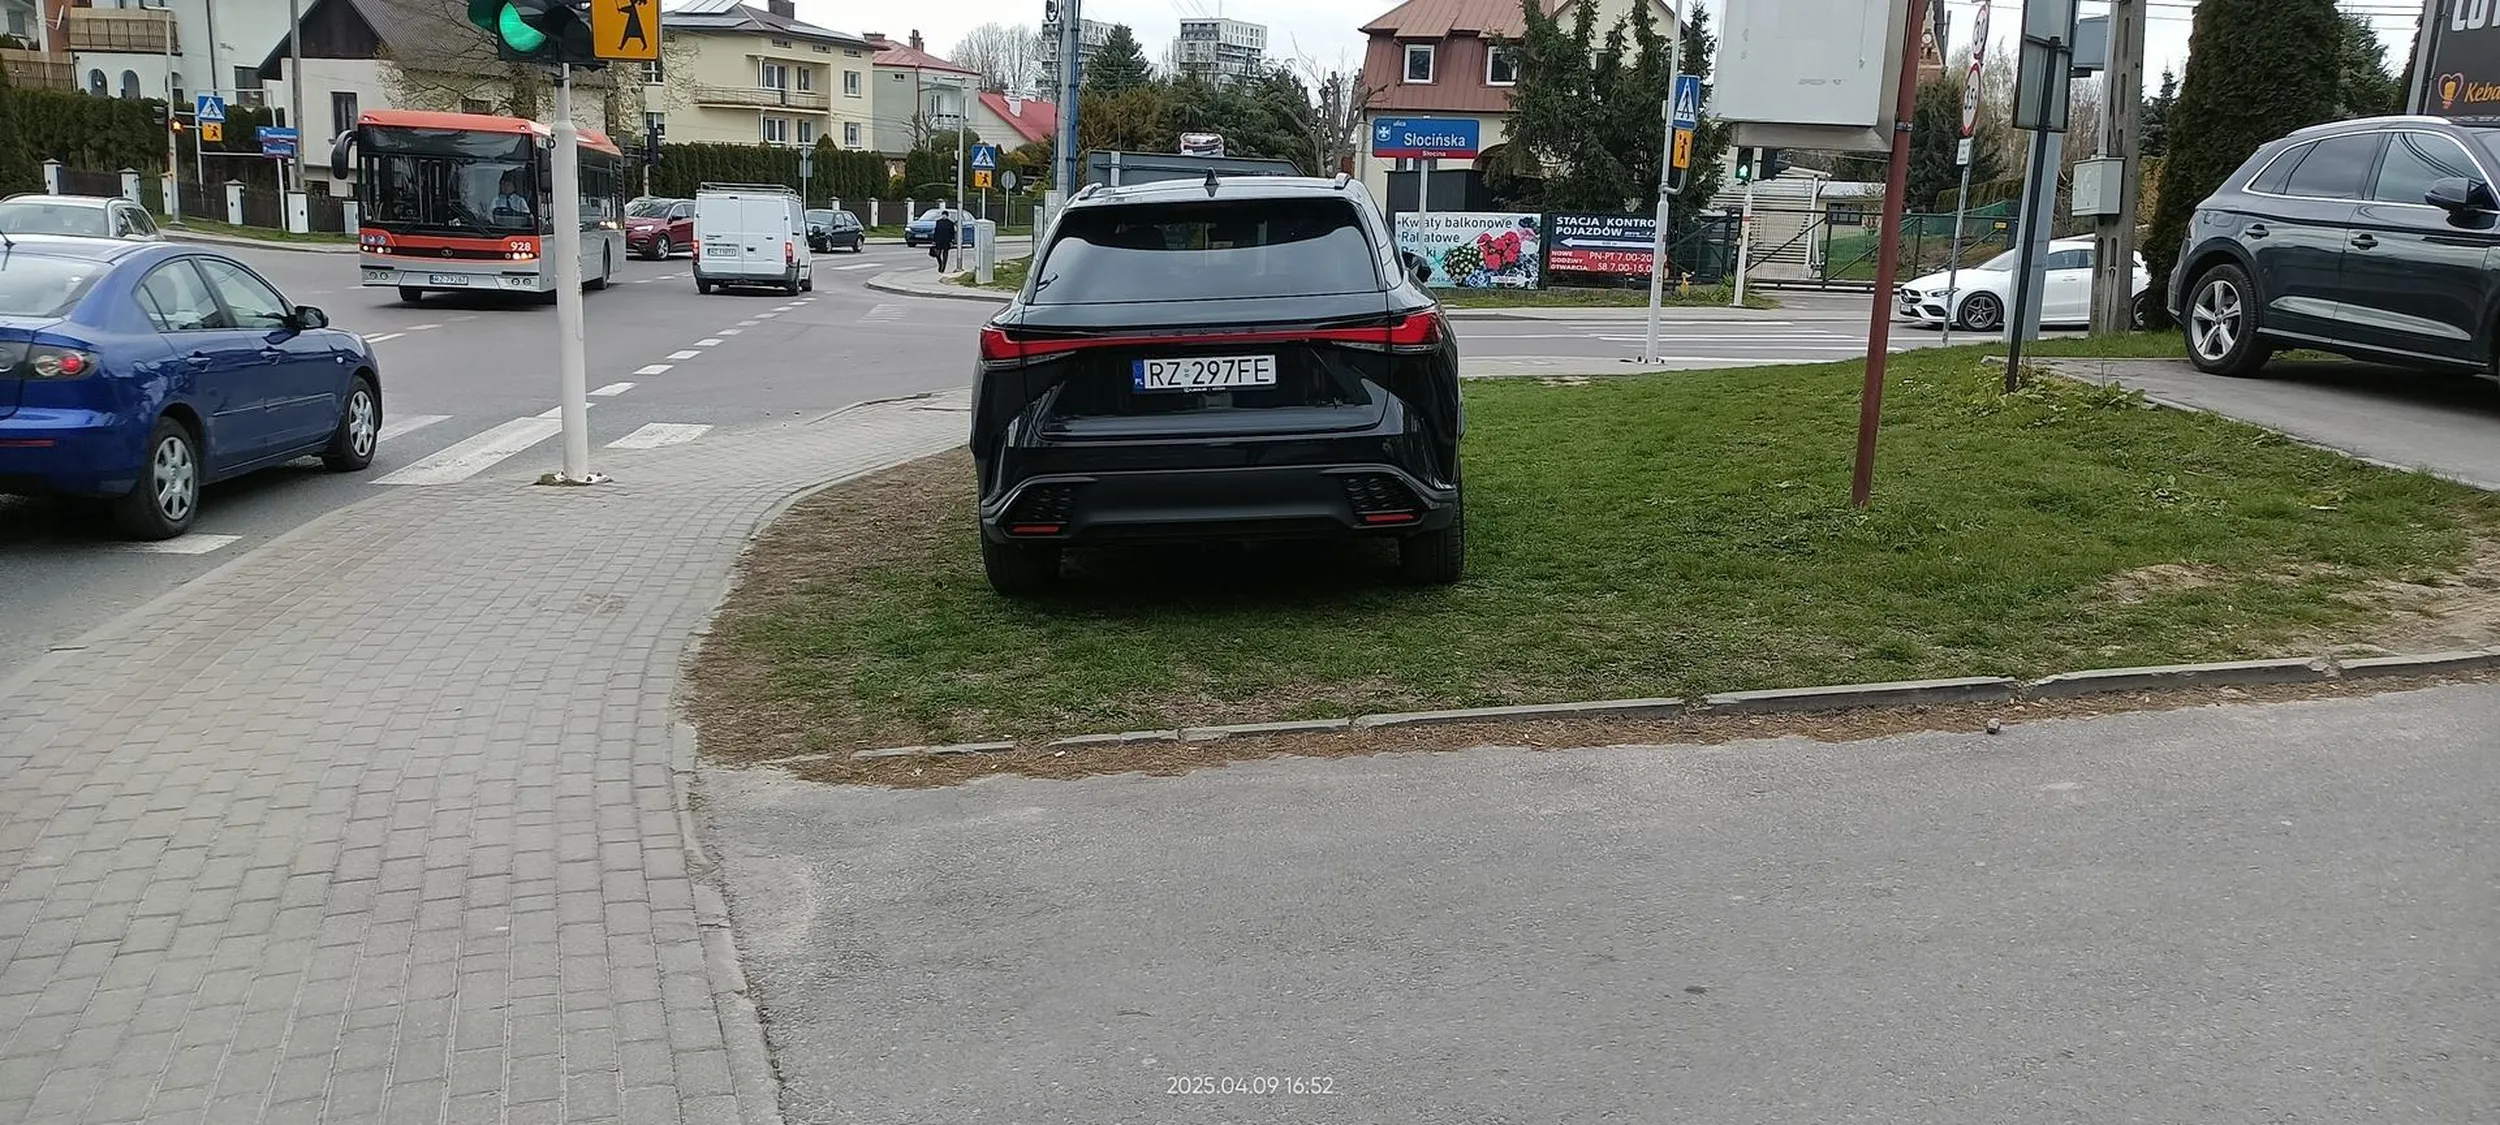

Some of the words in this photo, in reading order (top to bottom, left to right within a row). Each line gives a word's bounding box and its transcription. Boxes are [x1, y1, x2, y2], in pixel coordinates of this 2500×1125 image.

[1403, 132, 1466, 147] Słocińska
[1445, 217, 1512, 229] balkonowe
[1556, 216, 1600, 227] STACJA
[1606, 218, 1656, 228] KONTRO
[1555, 226, 1622, 237] POJAZDÓW
[510, 241, 531, 252] 928
[1589, 251, 1616, 261] PN-PT
[1149, 361, 1182, 387] RZ
[1192, 358, 1270, 385] 297FE
